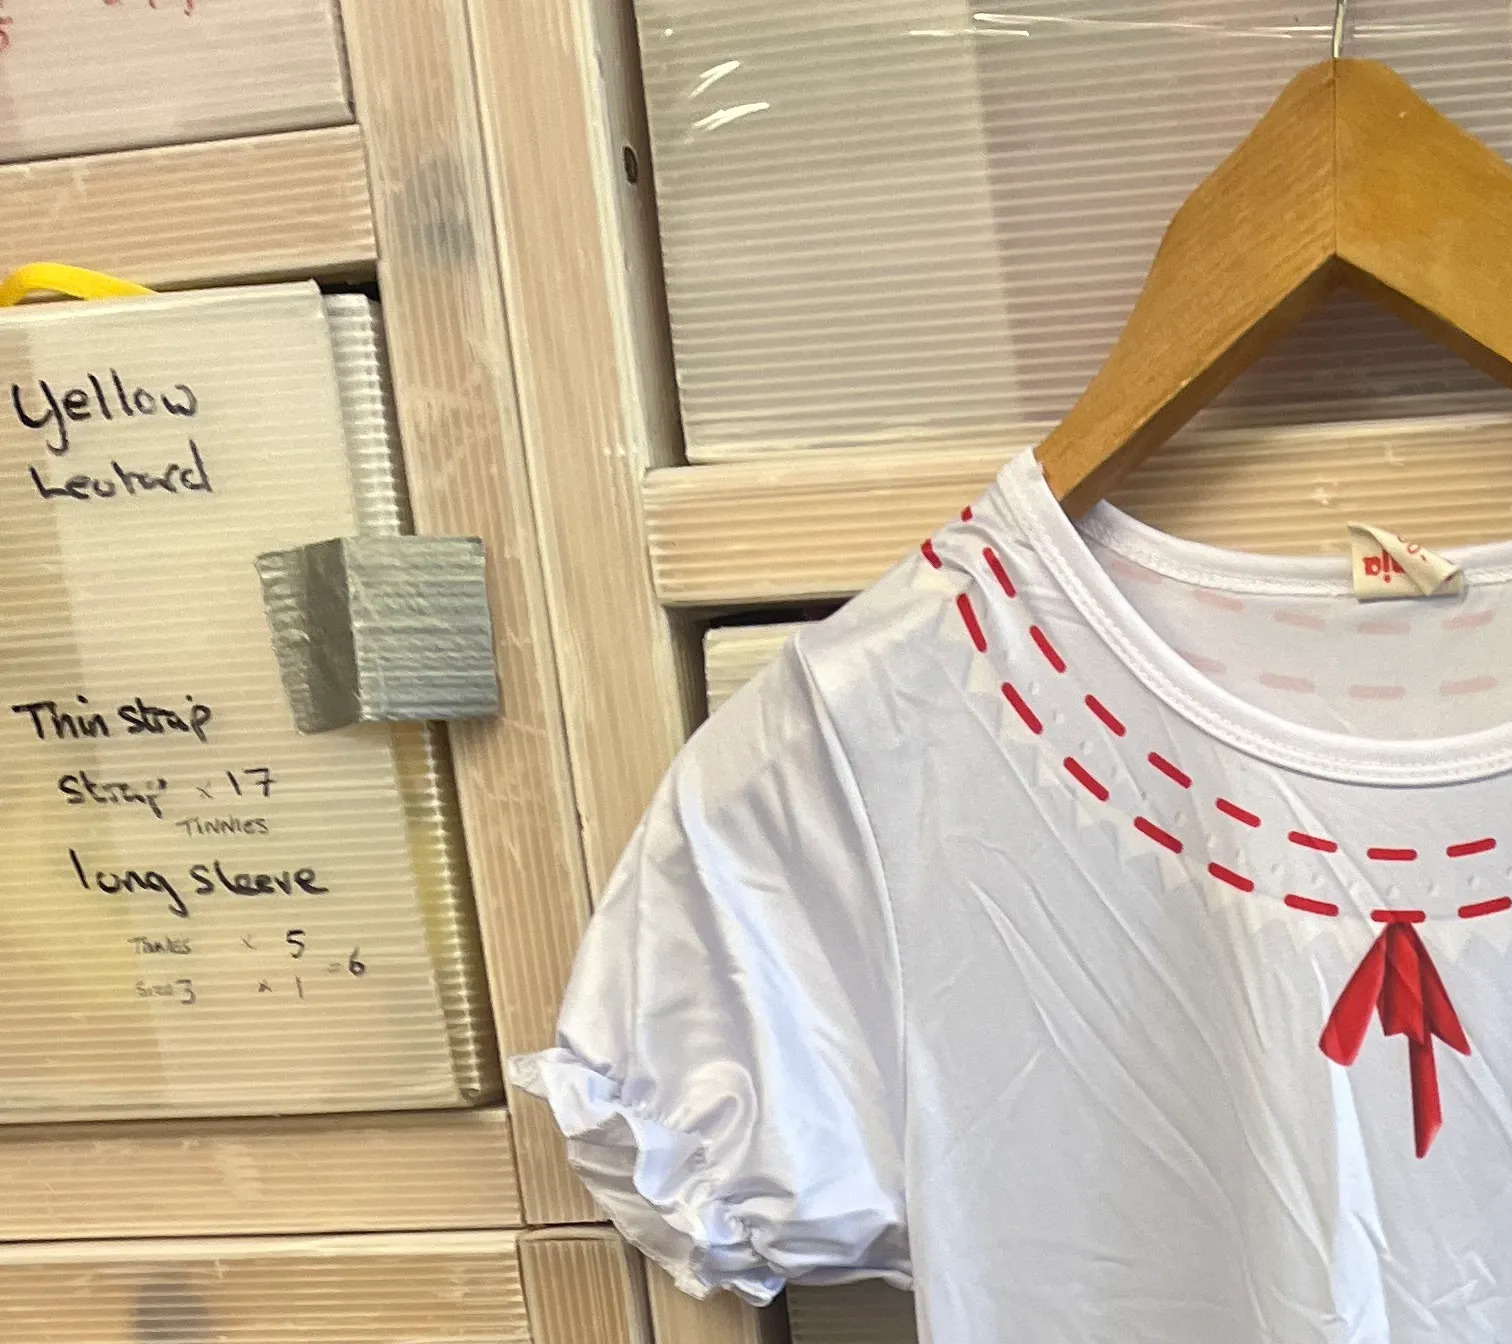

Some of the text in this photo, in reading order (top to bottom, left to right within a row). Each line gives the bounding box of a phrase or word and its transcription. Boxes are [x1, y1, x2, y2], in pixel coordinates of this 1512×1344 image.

[12, 368, 198, 457] Yellow
[28, 438, 213, 500] Leotard
[12, 694, 110, 740] Thin
[226, 767, 278, 798] 17
[286, 929, 306, 959] 5
[349, 946, 367, 978] 6
